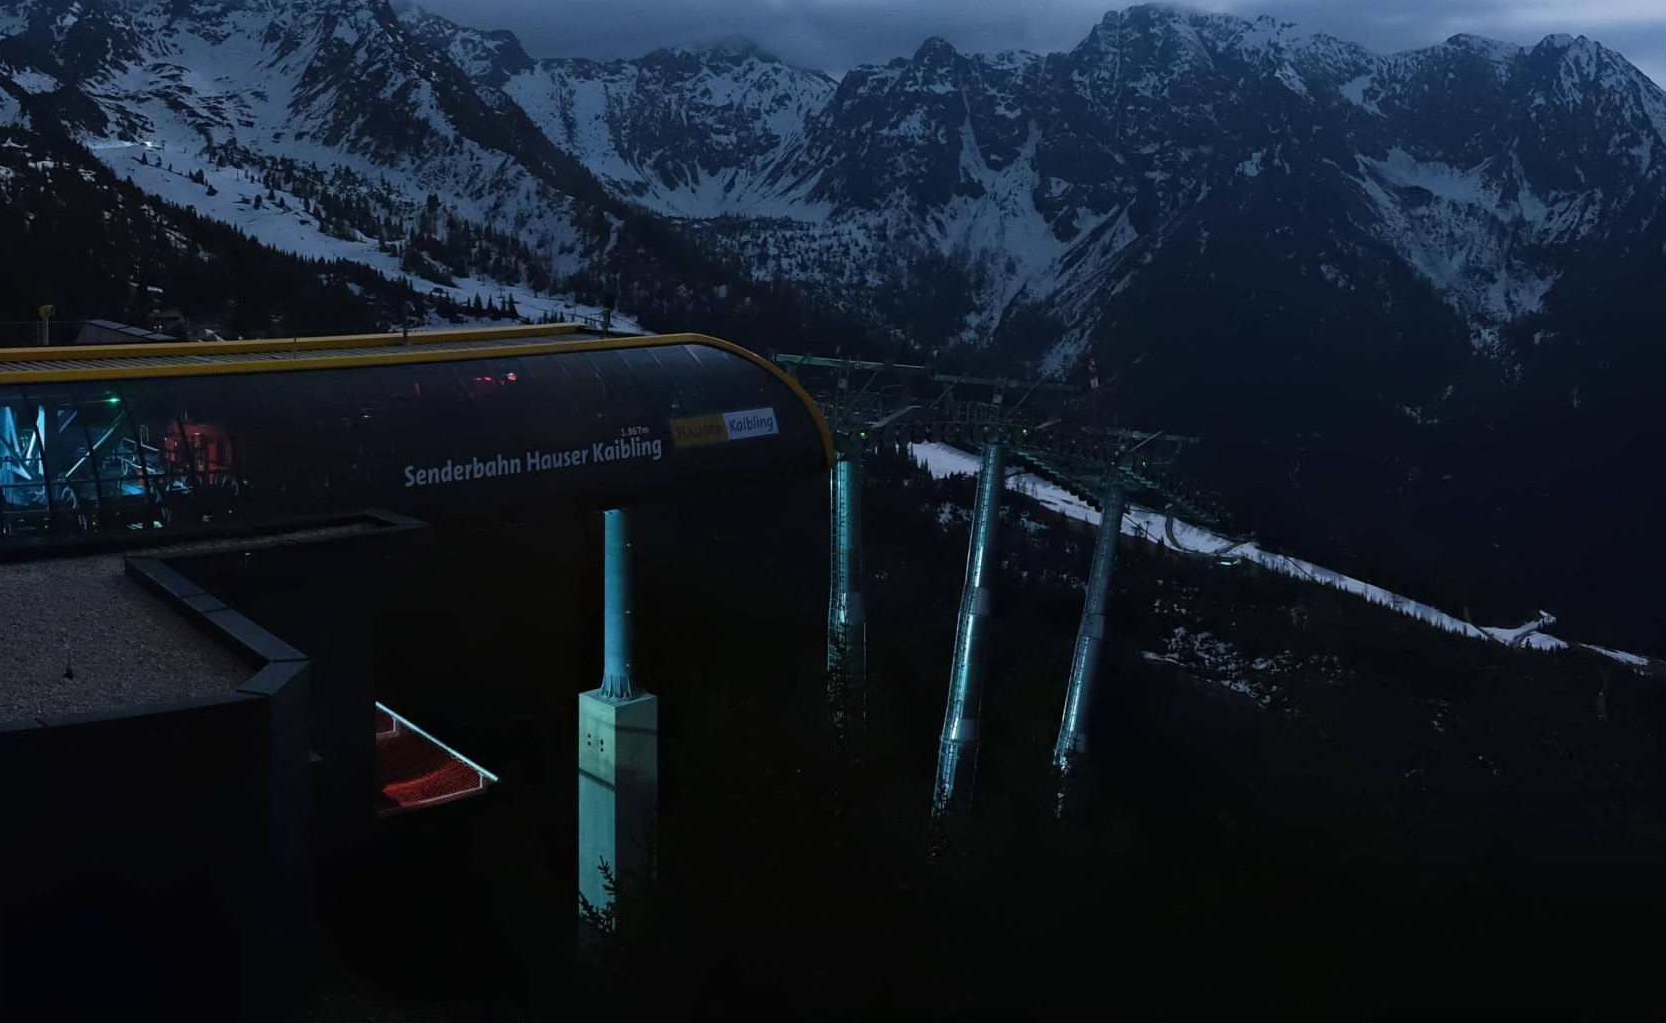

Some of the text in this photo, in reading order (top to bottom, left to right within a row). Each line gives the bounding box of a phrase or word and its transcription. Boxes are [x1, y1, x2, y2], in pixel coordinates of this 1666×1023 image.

[620, 425, 649, 437] 1.867m
[676, 414, 773, 441] HAUSER Kaibling
[404, 436, 663, 488] Senderbahn Hauser Kaibling
